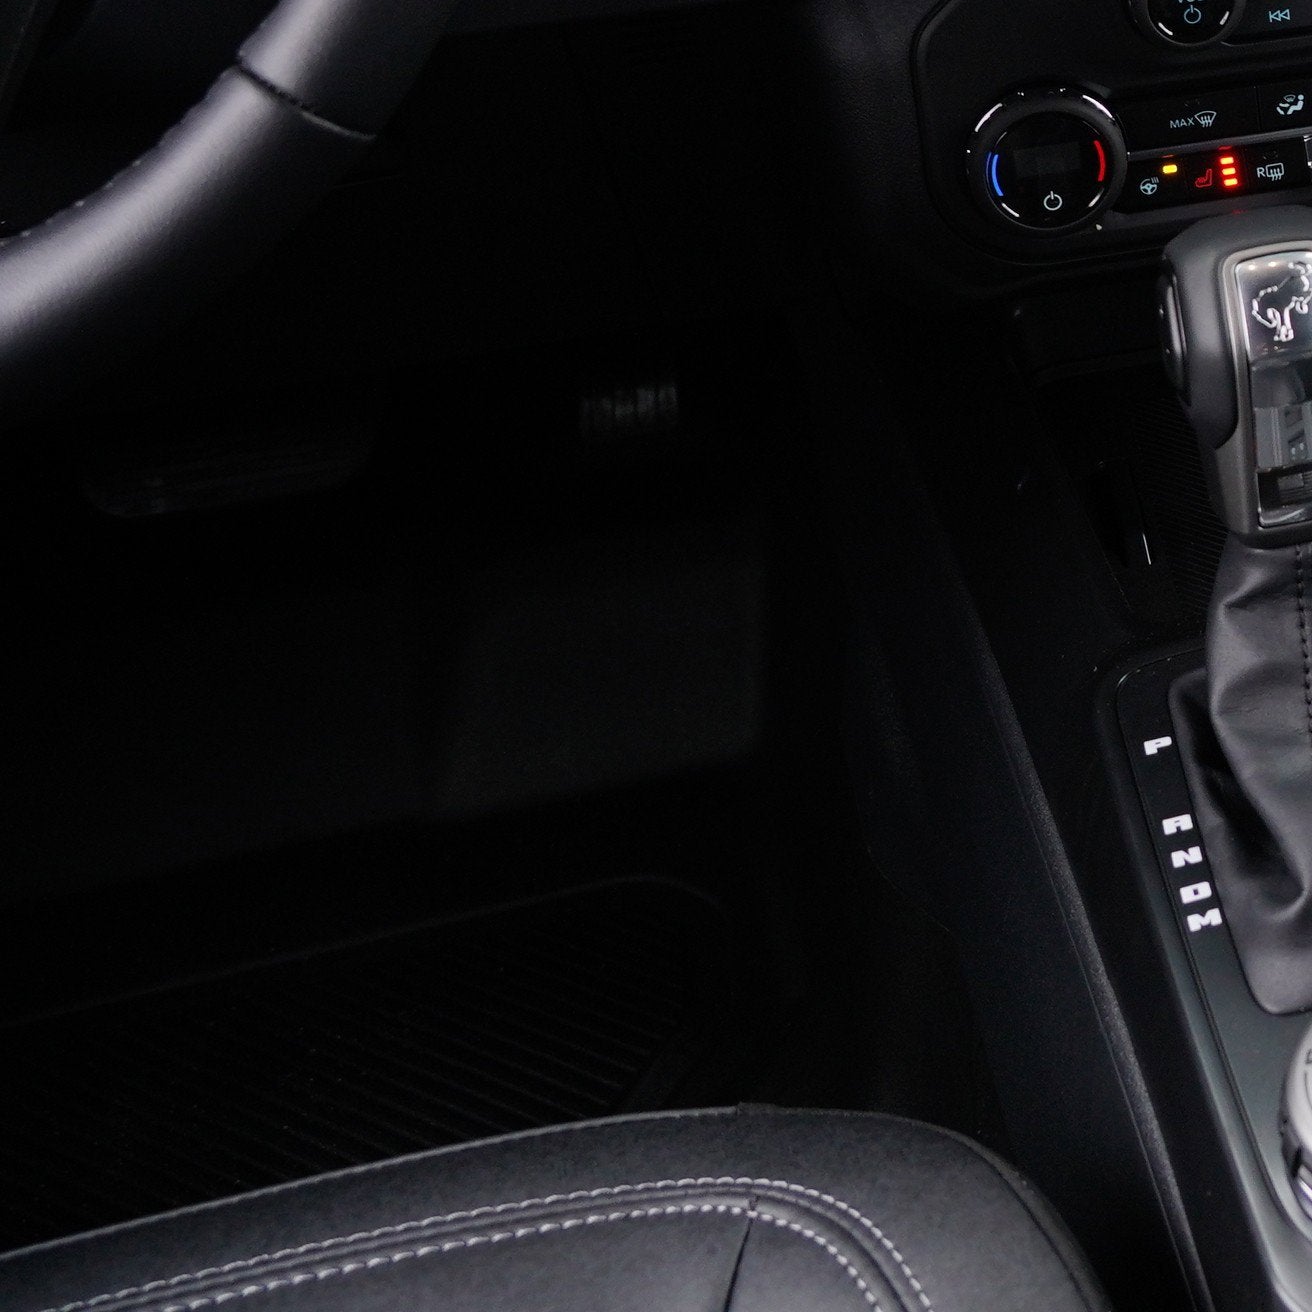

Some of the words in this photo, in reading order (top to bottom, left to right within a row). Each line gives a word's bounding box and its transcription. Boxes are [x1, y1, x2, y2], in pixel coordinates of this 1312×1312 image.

[1169, 117, 1195, 129] MAX
[1256, 166, 1266, 178] R
[1143, 736, 1173, 756] P
[1171, 845, 1203, 869] N
[1180, 881, 1212, 905] D
[1186, 907, 1223, 932] M
